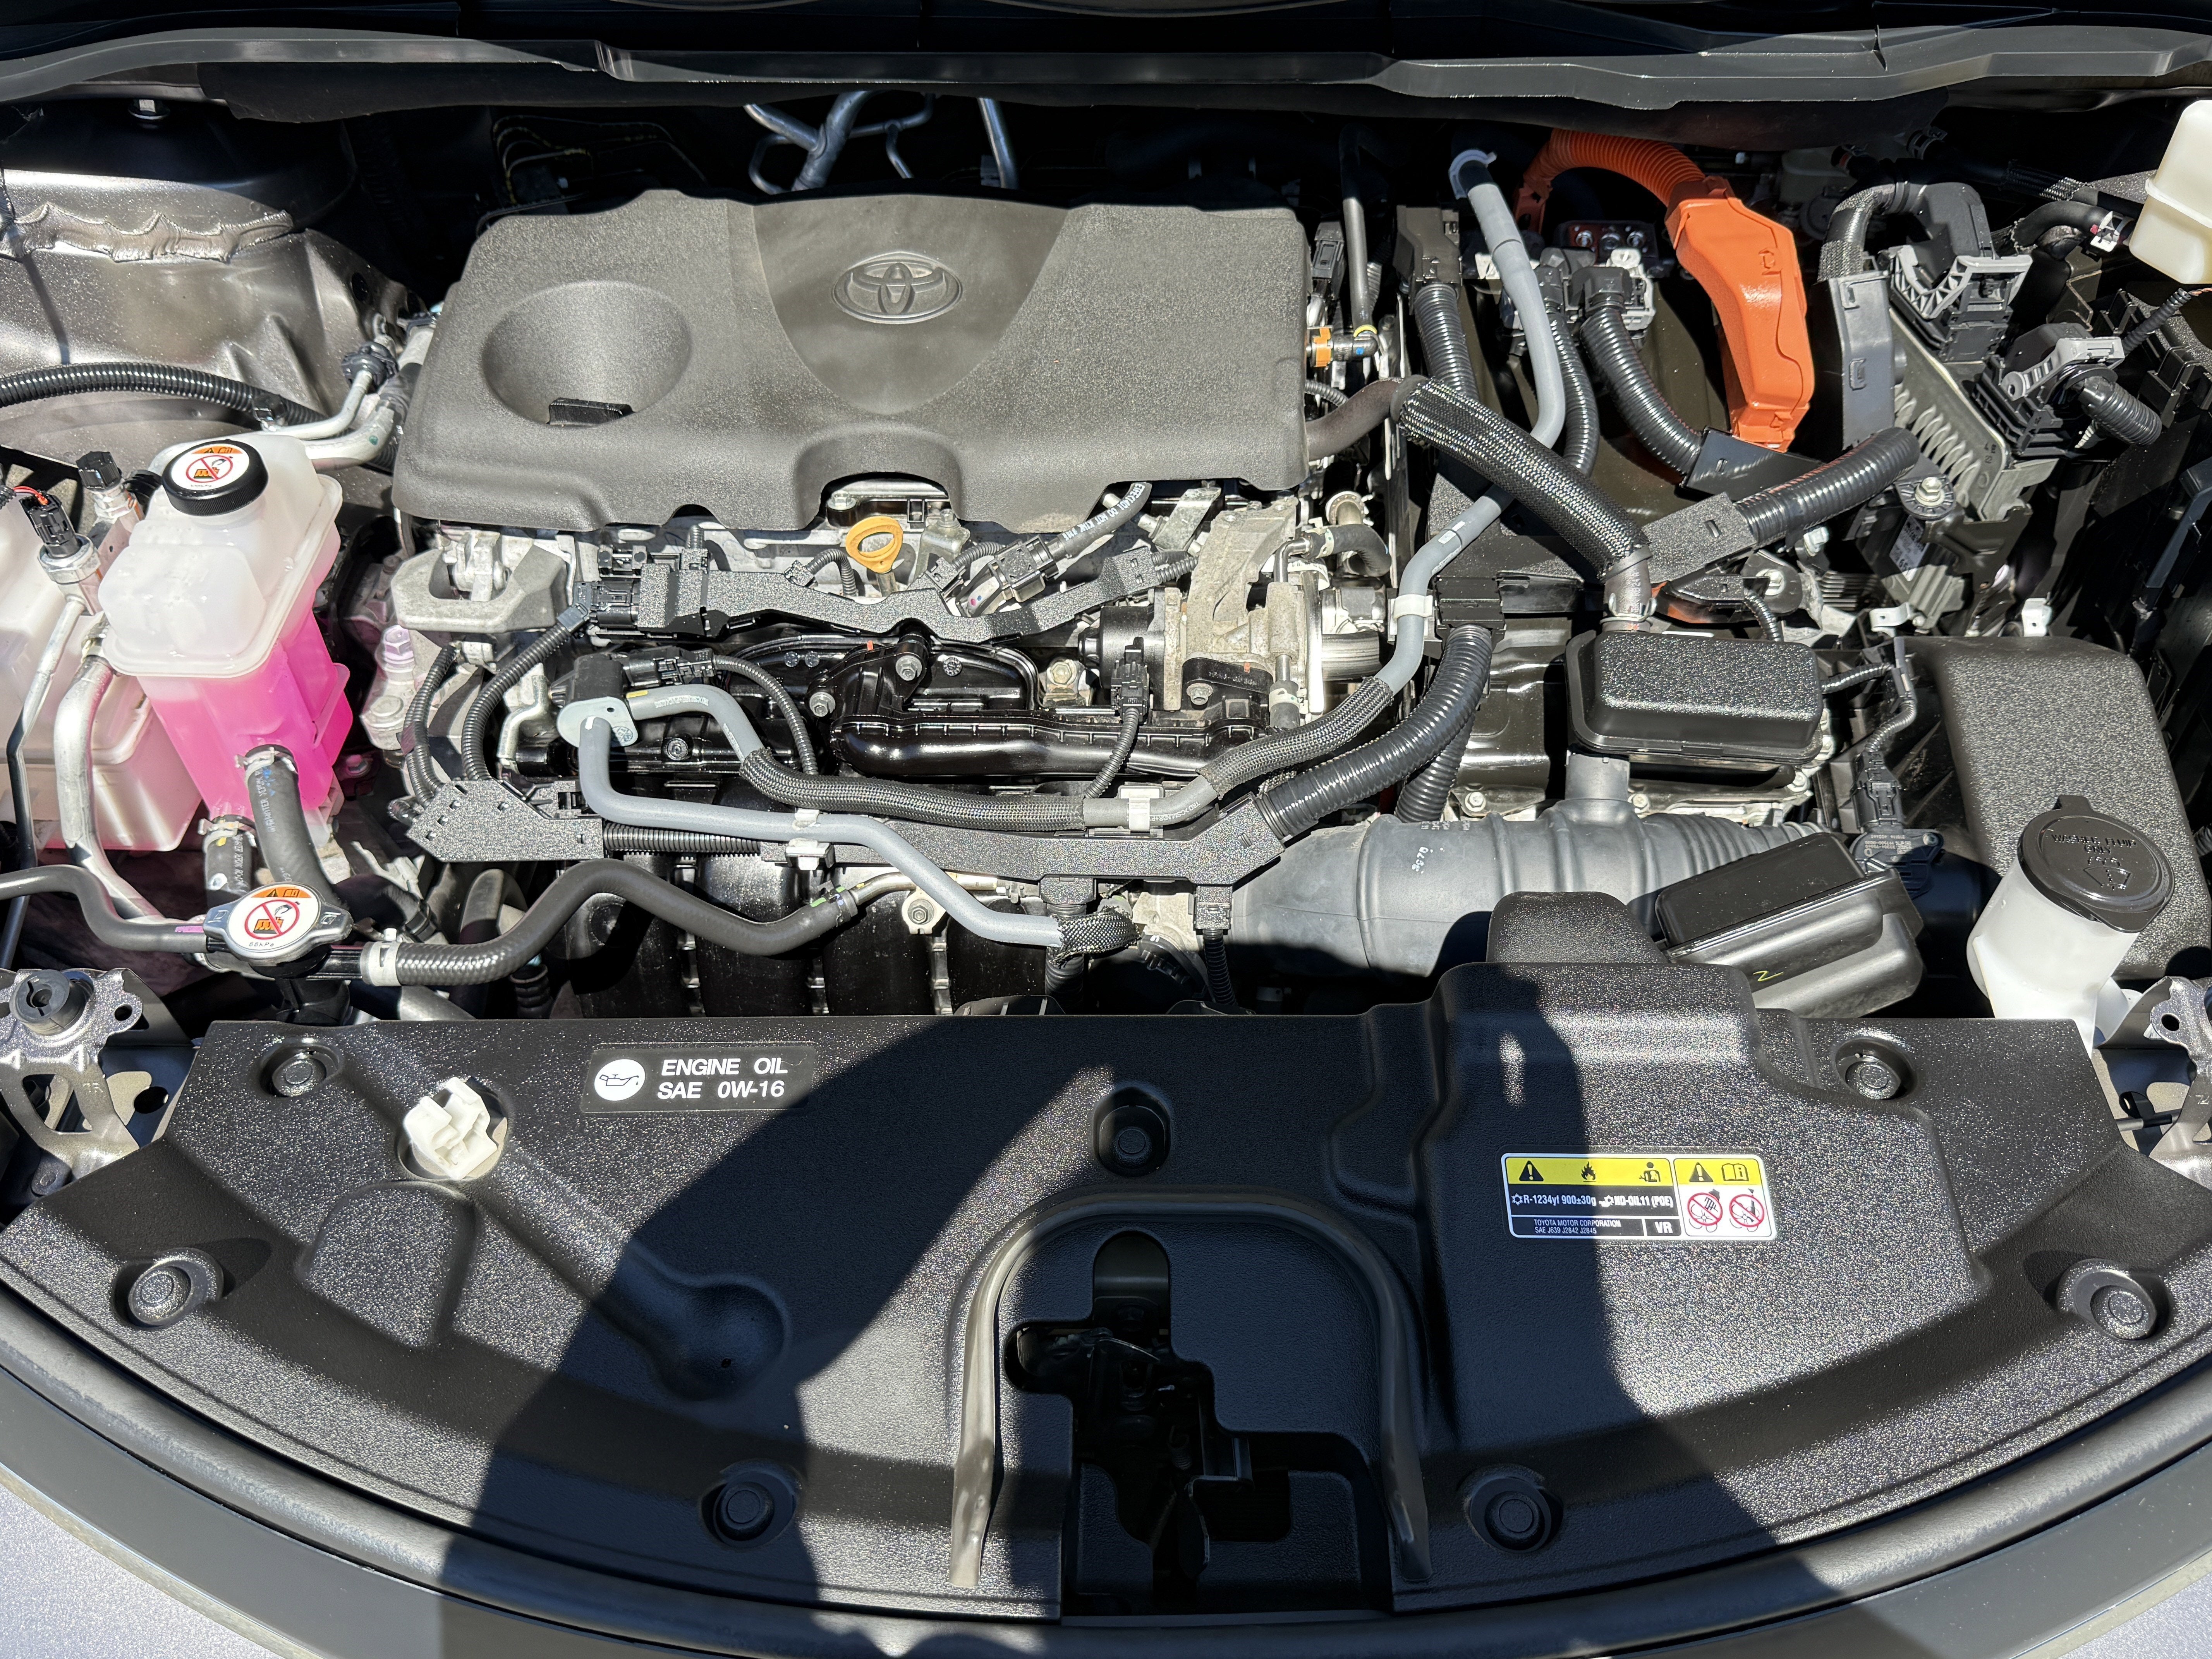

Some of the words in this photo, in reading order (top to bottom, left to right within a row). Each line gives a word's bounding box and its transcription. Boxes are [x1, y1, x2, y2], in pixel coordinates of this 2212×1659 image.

[1864, 848, 1873, 857] D
[661, 1058, 741, 1076] ENGINE
[754, 1057, 788, 1074] OIL
[657, 1081, 702, 1099] SAE
[717, 1080, 785, 1098] 0W-16
[1523, 1195, 1559, 1206] R-1234yf
[1562, 1195, 1596, 1206] 900±30g
[1651, 1196, 1673, 1208] (POE)
[1655, 1222, 1673, 1233] VR
